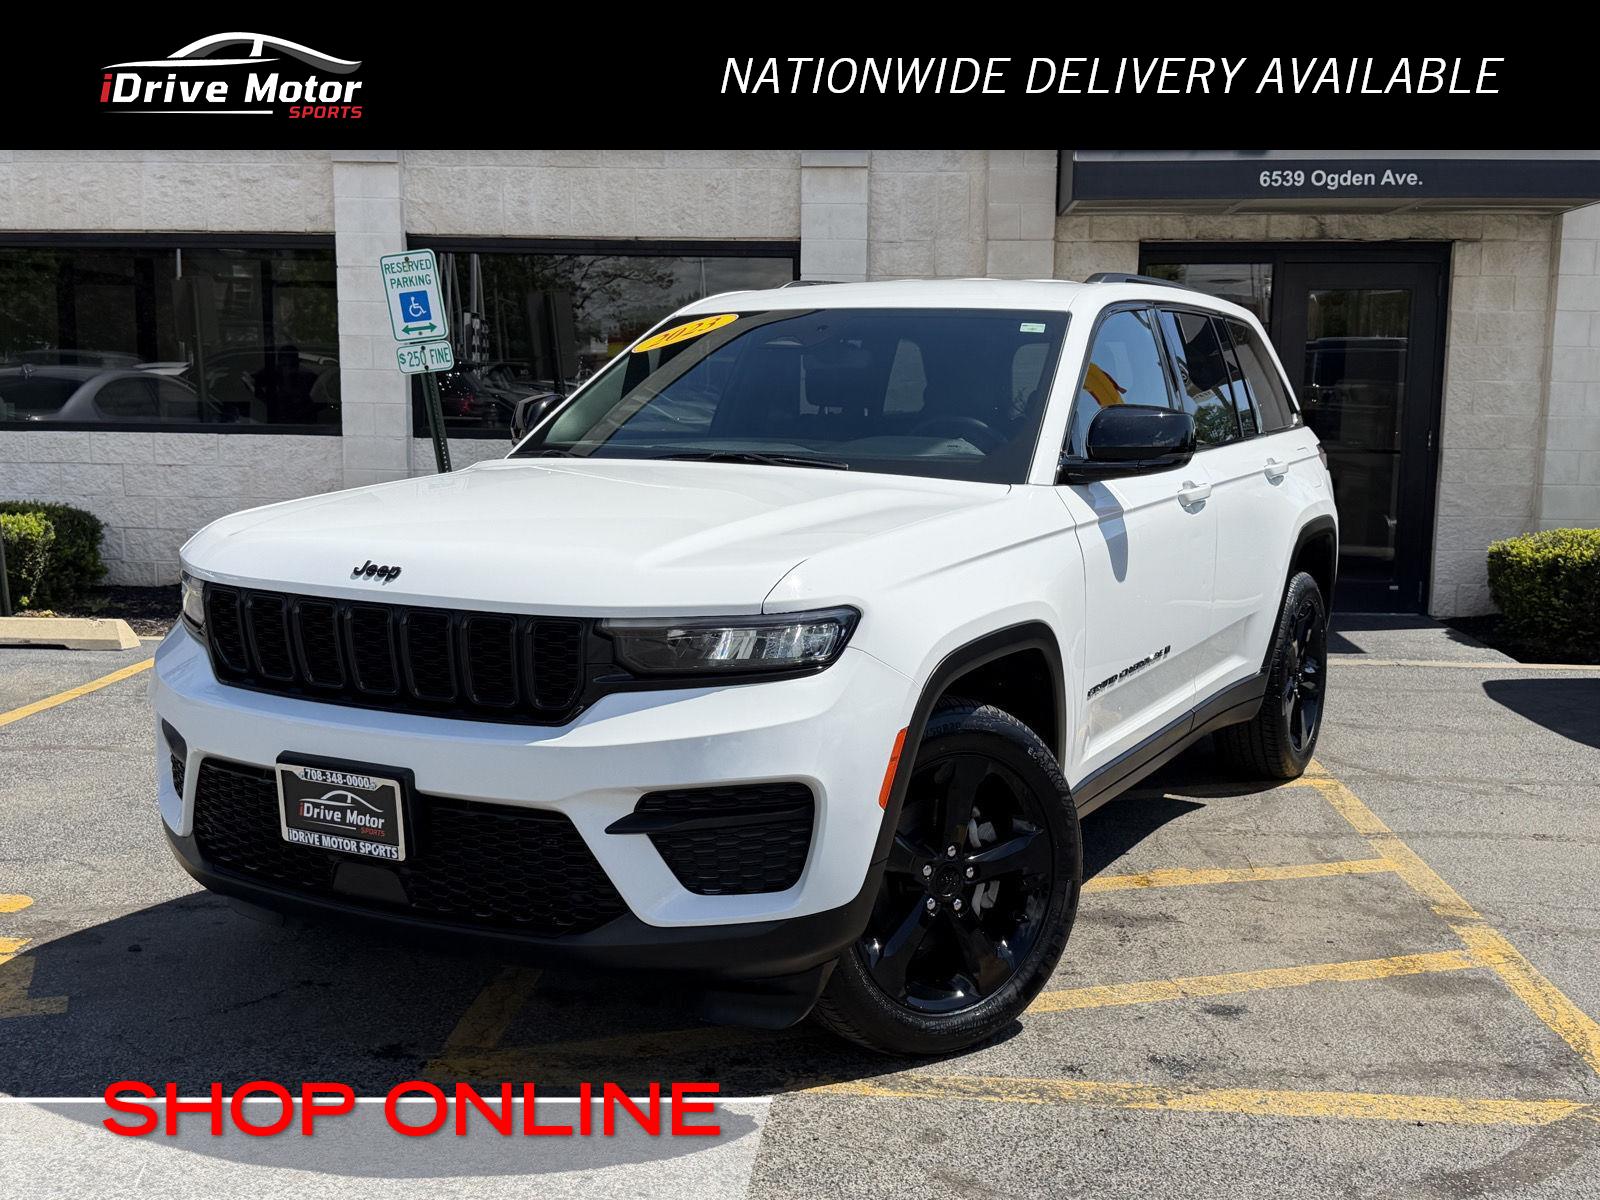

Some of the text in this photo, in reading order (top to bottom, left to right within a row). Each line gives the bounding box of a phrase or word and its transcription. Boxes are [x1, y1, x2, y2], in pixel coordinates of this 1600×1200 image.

[1259, 169, 1423, 190] 6539 Ogden Ave.
[383, 258, 432, 275] RESERVED
[390, 274, 432, 289] PARKING
[646, 316, 722, 349] 2023
[430, 346, 452, 366] FINE
[353, 559, 402, 583] Jeep
[304, 768, 370, 789] 708-348-0000
[298, 802, 385, 829] iDrive Motor
[360, 826, 385, 837] SPORTS
[321, 835, 358, 853] MOTOR
[359, 842, 399, 859] SPORTS
